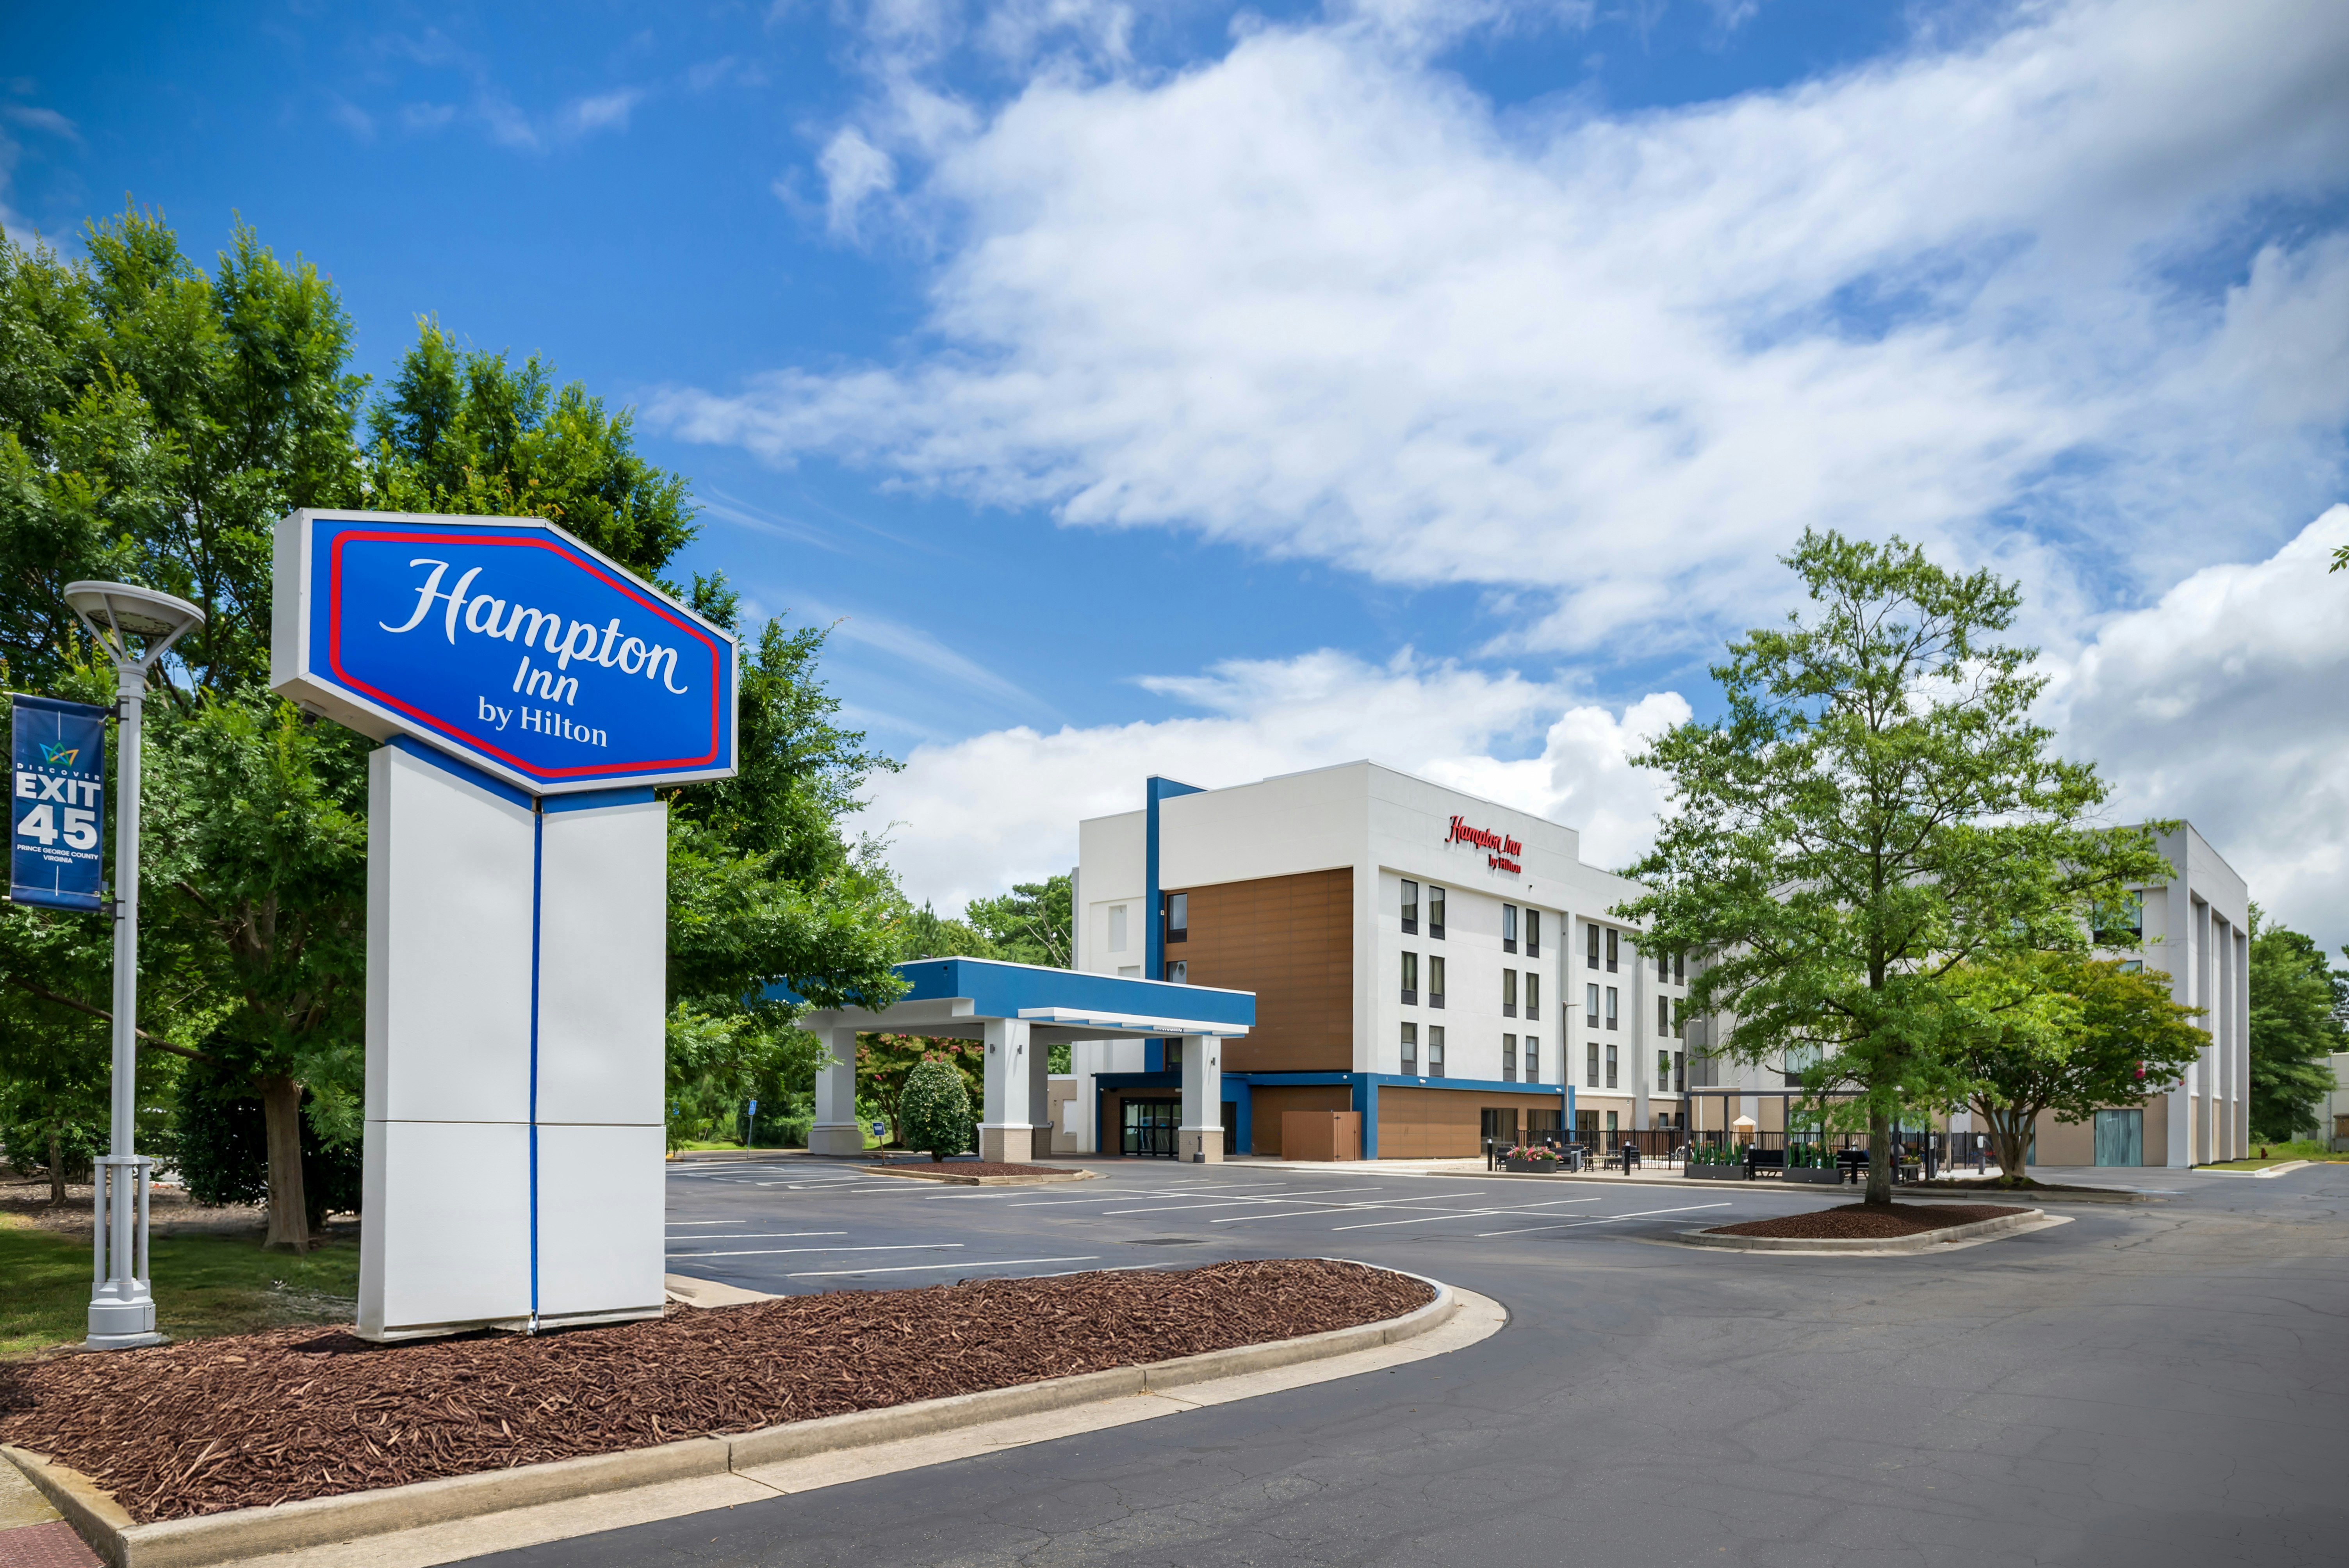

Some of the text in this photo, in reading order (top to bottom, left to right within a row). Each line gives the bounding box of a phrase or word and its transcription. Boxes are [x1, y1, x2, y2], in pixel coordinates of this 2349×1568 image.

[379, 558, 688, 695] Hampton
[512, 656, 579, 706] Inn
[478, 695, 608, 748] by Hilton
[16, 771, 101, 807] EXIT
[17, 763, 100, 780] DISCOVER
[18, 804, 98, 850] 45
[1444, 815, 1522, 856] Hampton Inn
[17, 844, 98, 860] PRINCE GEORGE COUNTY
[43, 855, 73, 863] VIRGINIA
[1488, 854, 1521, 873] by Hilton
